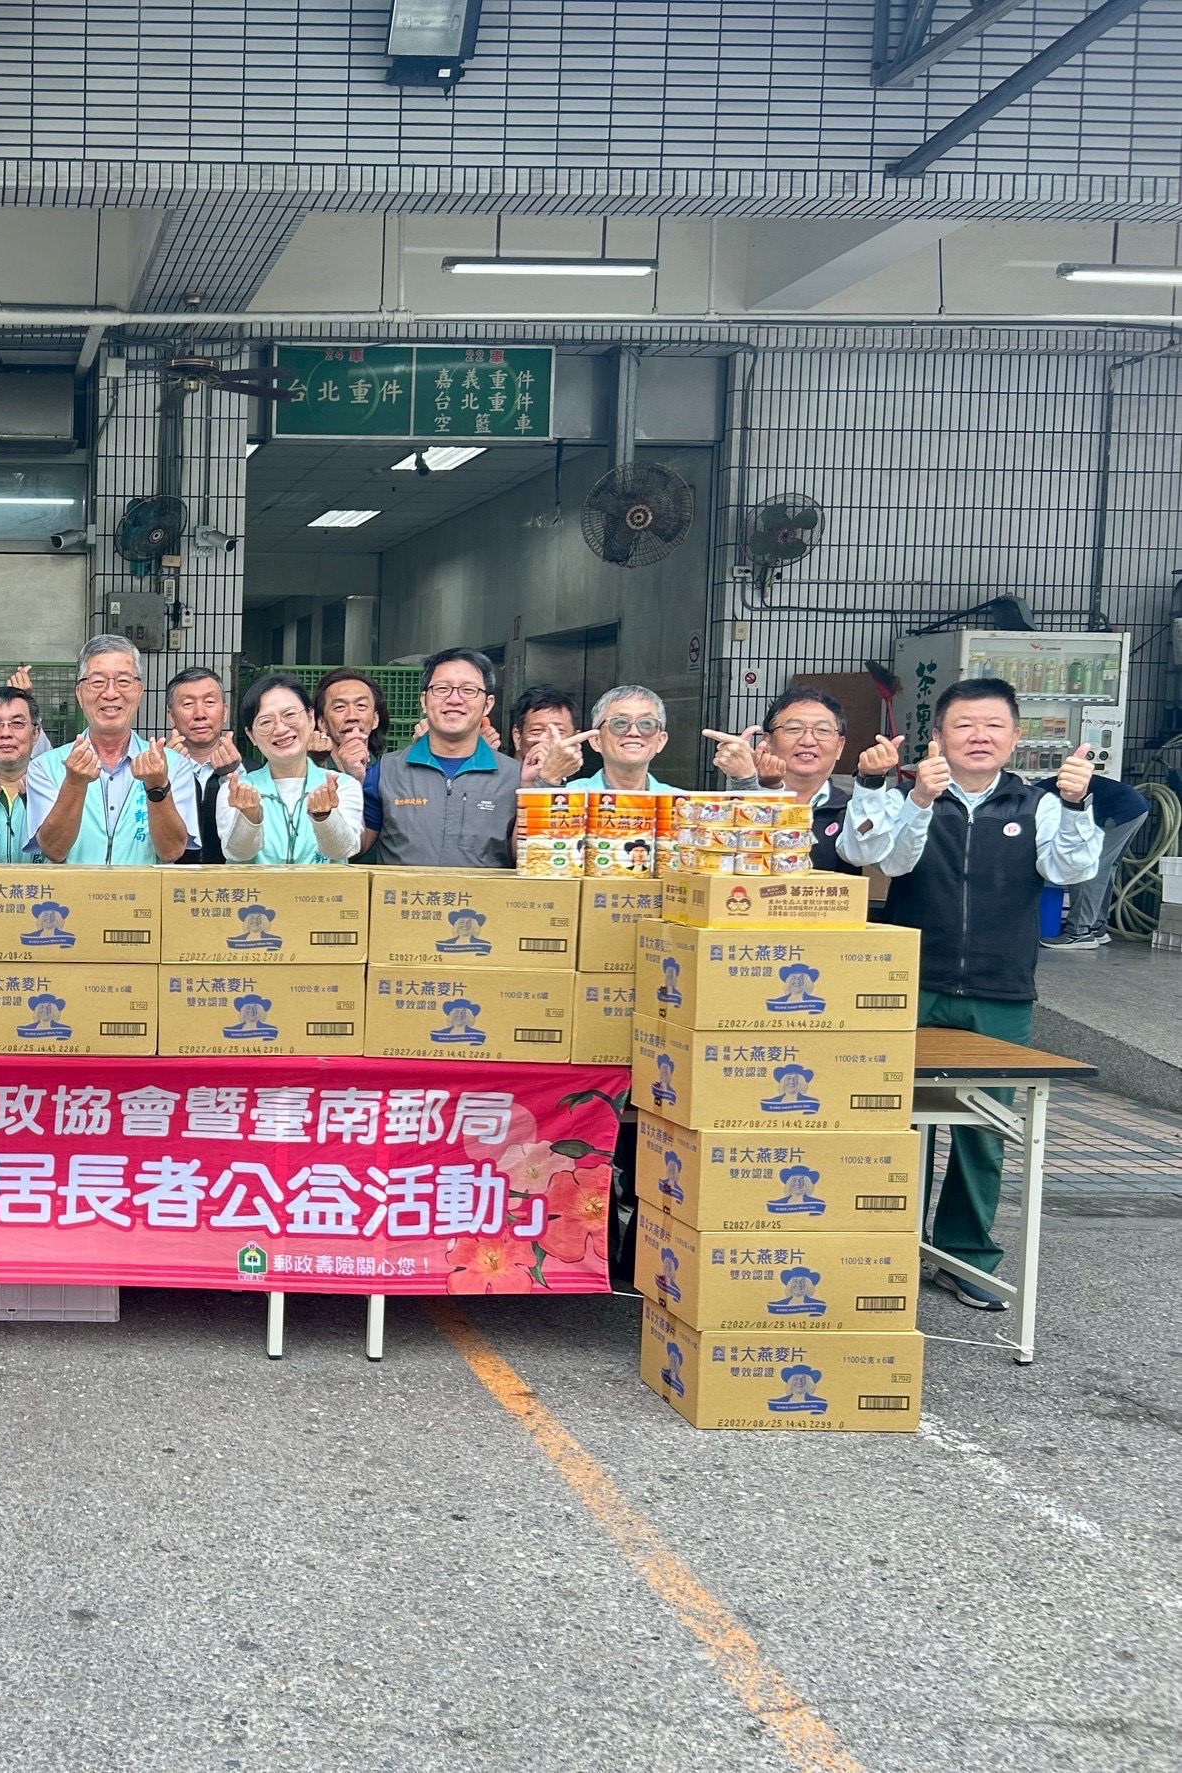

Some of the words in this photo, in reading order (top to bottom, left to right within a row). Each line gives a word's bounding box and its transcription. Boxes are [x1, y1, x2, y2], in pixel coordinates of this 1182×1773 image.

[434, 367, 535, 391] 嘉義重件
[287, 379, 403, 405] 台北重件
[434, 392, 535, 413] 台北重件
[434, 413, 534, 435] 空籃車
[200, 888, 261, 902] 大燕麥片
[411, 891, 472, 906] 大燕麥片
[621, 894, 663, 909] 大燕麥
[191, 908, 231, 917] 雙效認證
[401, 910, 441, 920] 雙效認證
[739, 945, 804, 961] 大燕麥片
[729, 967, 772, 977] 雙效認證
[196, 978, 257, 992] 大燕麥片
[405, 981, 467, 996] 大燕麥片
[187, 997, 227, 1007] 雙效認證
[396, 1000, 436, 1010] 雙效認證
[734, 1046, 799, 1061] 大燕麥片
[723, 1067, 767, 1077] 雙效認證
[740, 1147, 805, 1163] 大燕麥片
[730, 1169, 772, 1179] 雙效認證
[740, 1249, 805, 1264] 大燕麥片
[730, 1270, 773, 1280] 雙效認證
[741, 1347, 807, 1362] 大燕麥片
[731, 1367, 774, 1377] 雙效認證
